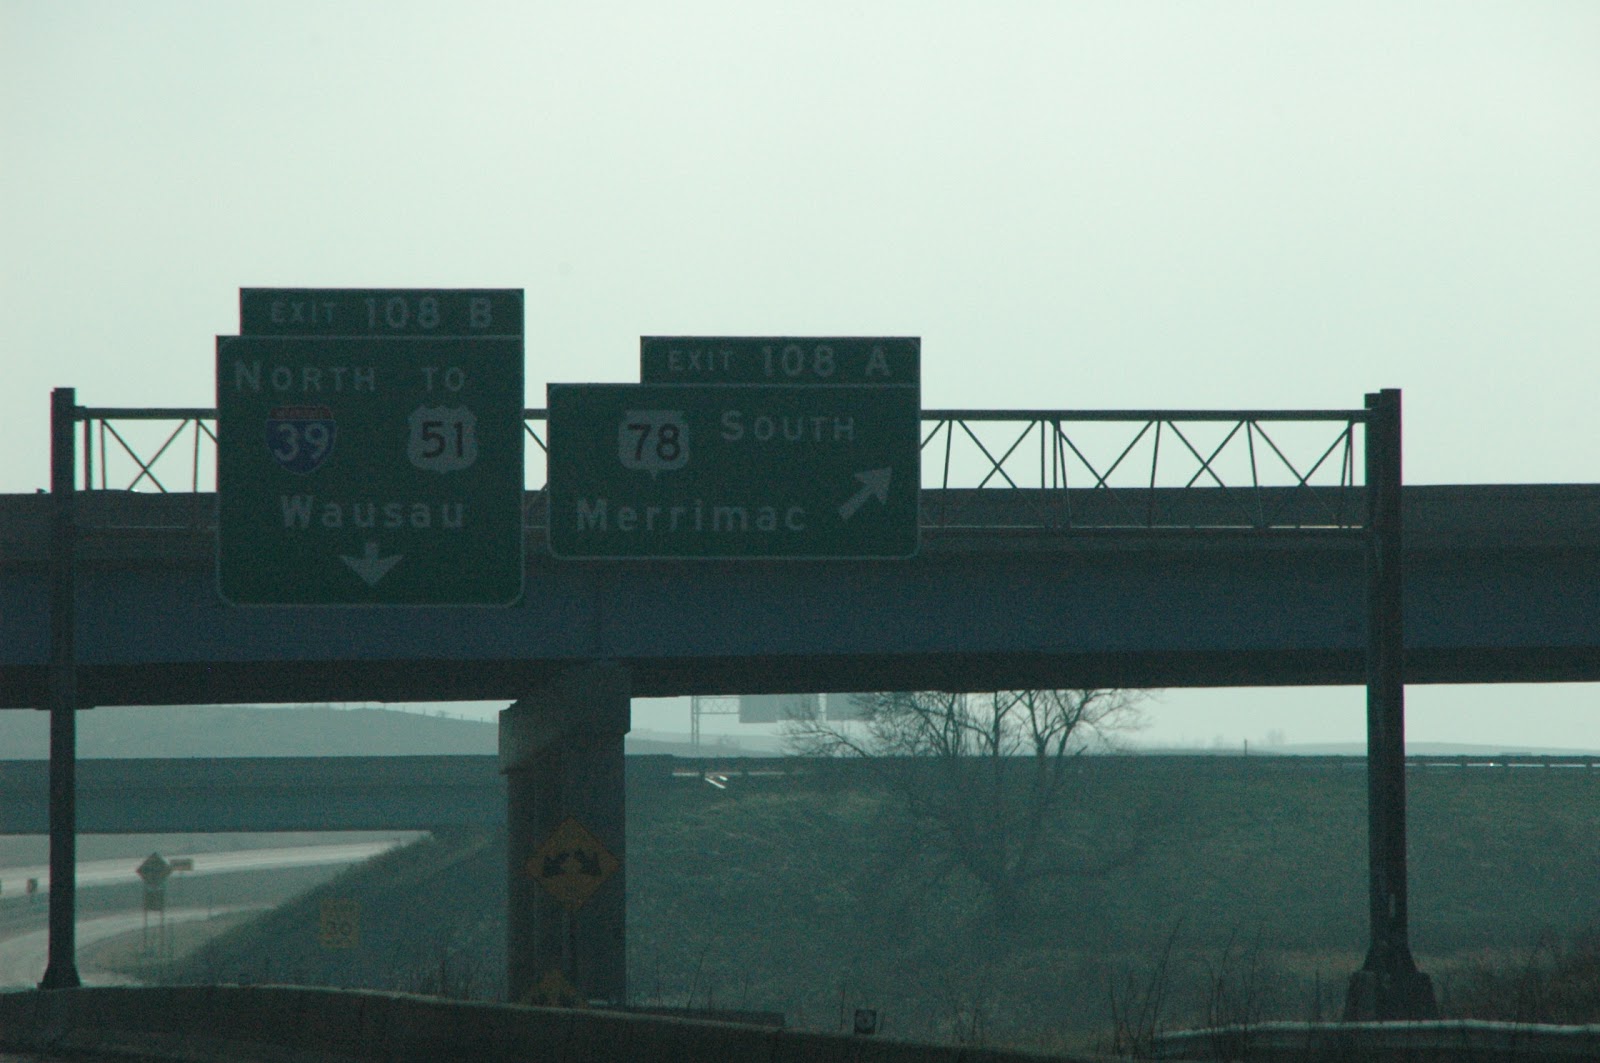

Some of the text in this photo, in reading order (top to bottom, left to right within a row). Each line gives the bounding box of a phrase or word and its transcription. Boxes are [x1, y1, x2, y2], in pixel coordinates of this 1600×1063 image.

[271, 297, 493, 329] EXIT 108 B
[234, 360, 376, 392] NORTH
[667, 345, 890, 377] EXIT 108 A
[421, 366, 466, 392] TO
[274, 422, 330, 462] 39
[421, 421, 463, 459] 51
[720, 410, 855, 442] SOUTH
[627, 423, 681, 462] 78
[279, 494, 463, 529] Wausau
[575, 498, 807, 531] Merrimac
